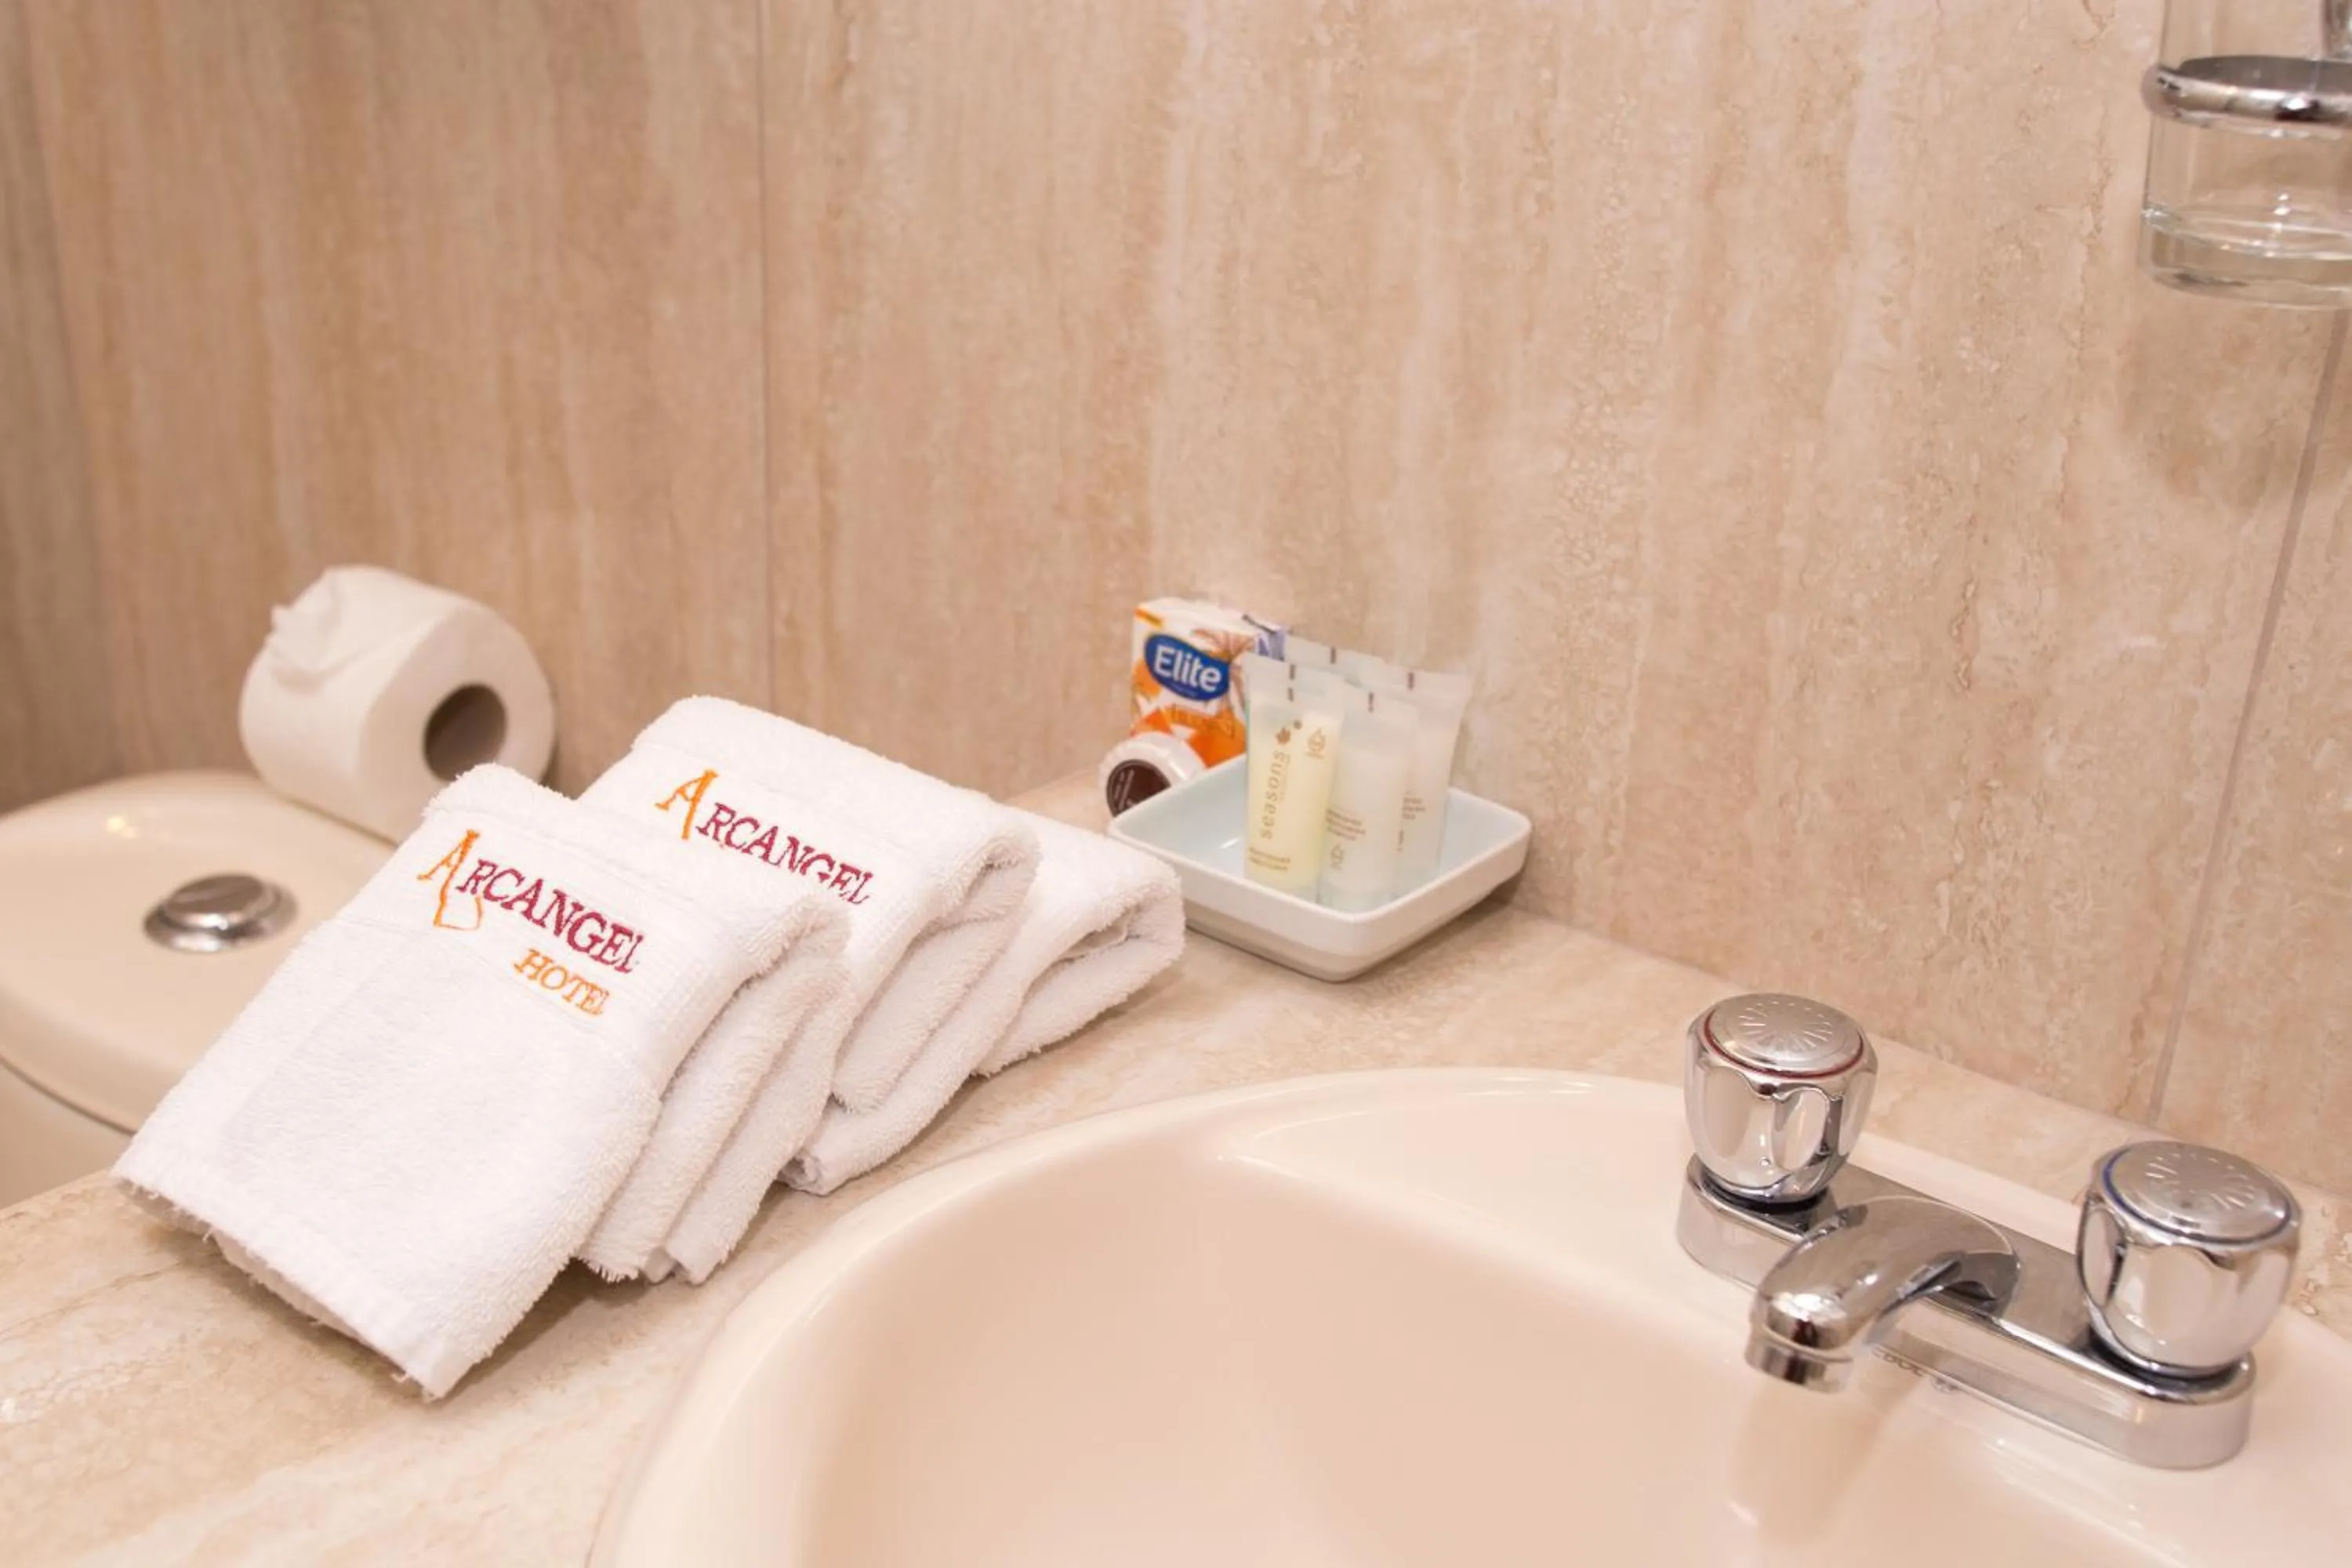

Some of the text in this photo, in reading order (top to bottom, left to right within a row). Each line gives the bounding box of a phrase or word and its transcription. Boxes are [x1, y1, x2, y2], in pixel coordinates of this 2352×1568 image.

[1154, 645, 1221, 692] Elite
[655, 769, 874, 905] ARCANGEL
[1259, 750, 1288, 840] seasons
[417, 829, 644, 973] ARCANGEL
[514, 949, 610, 1016] HOTEL
